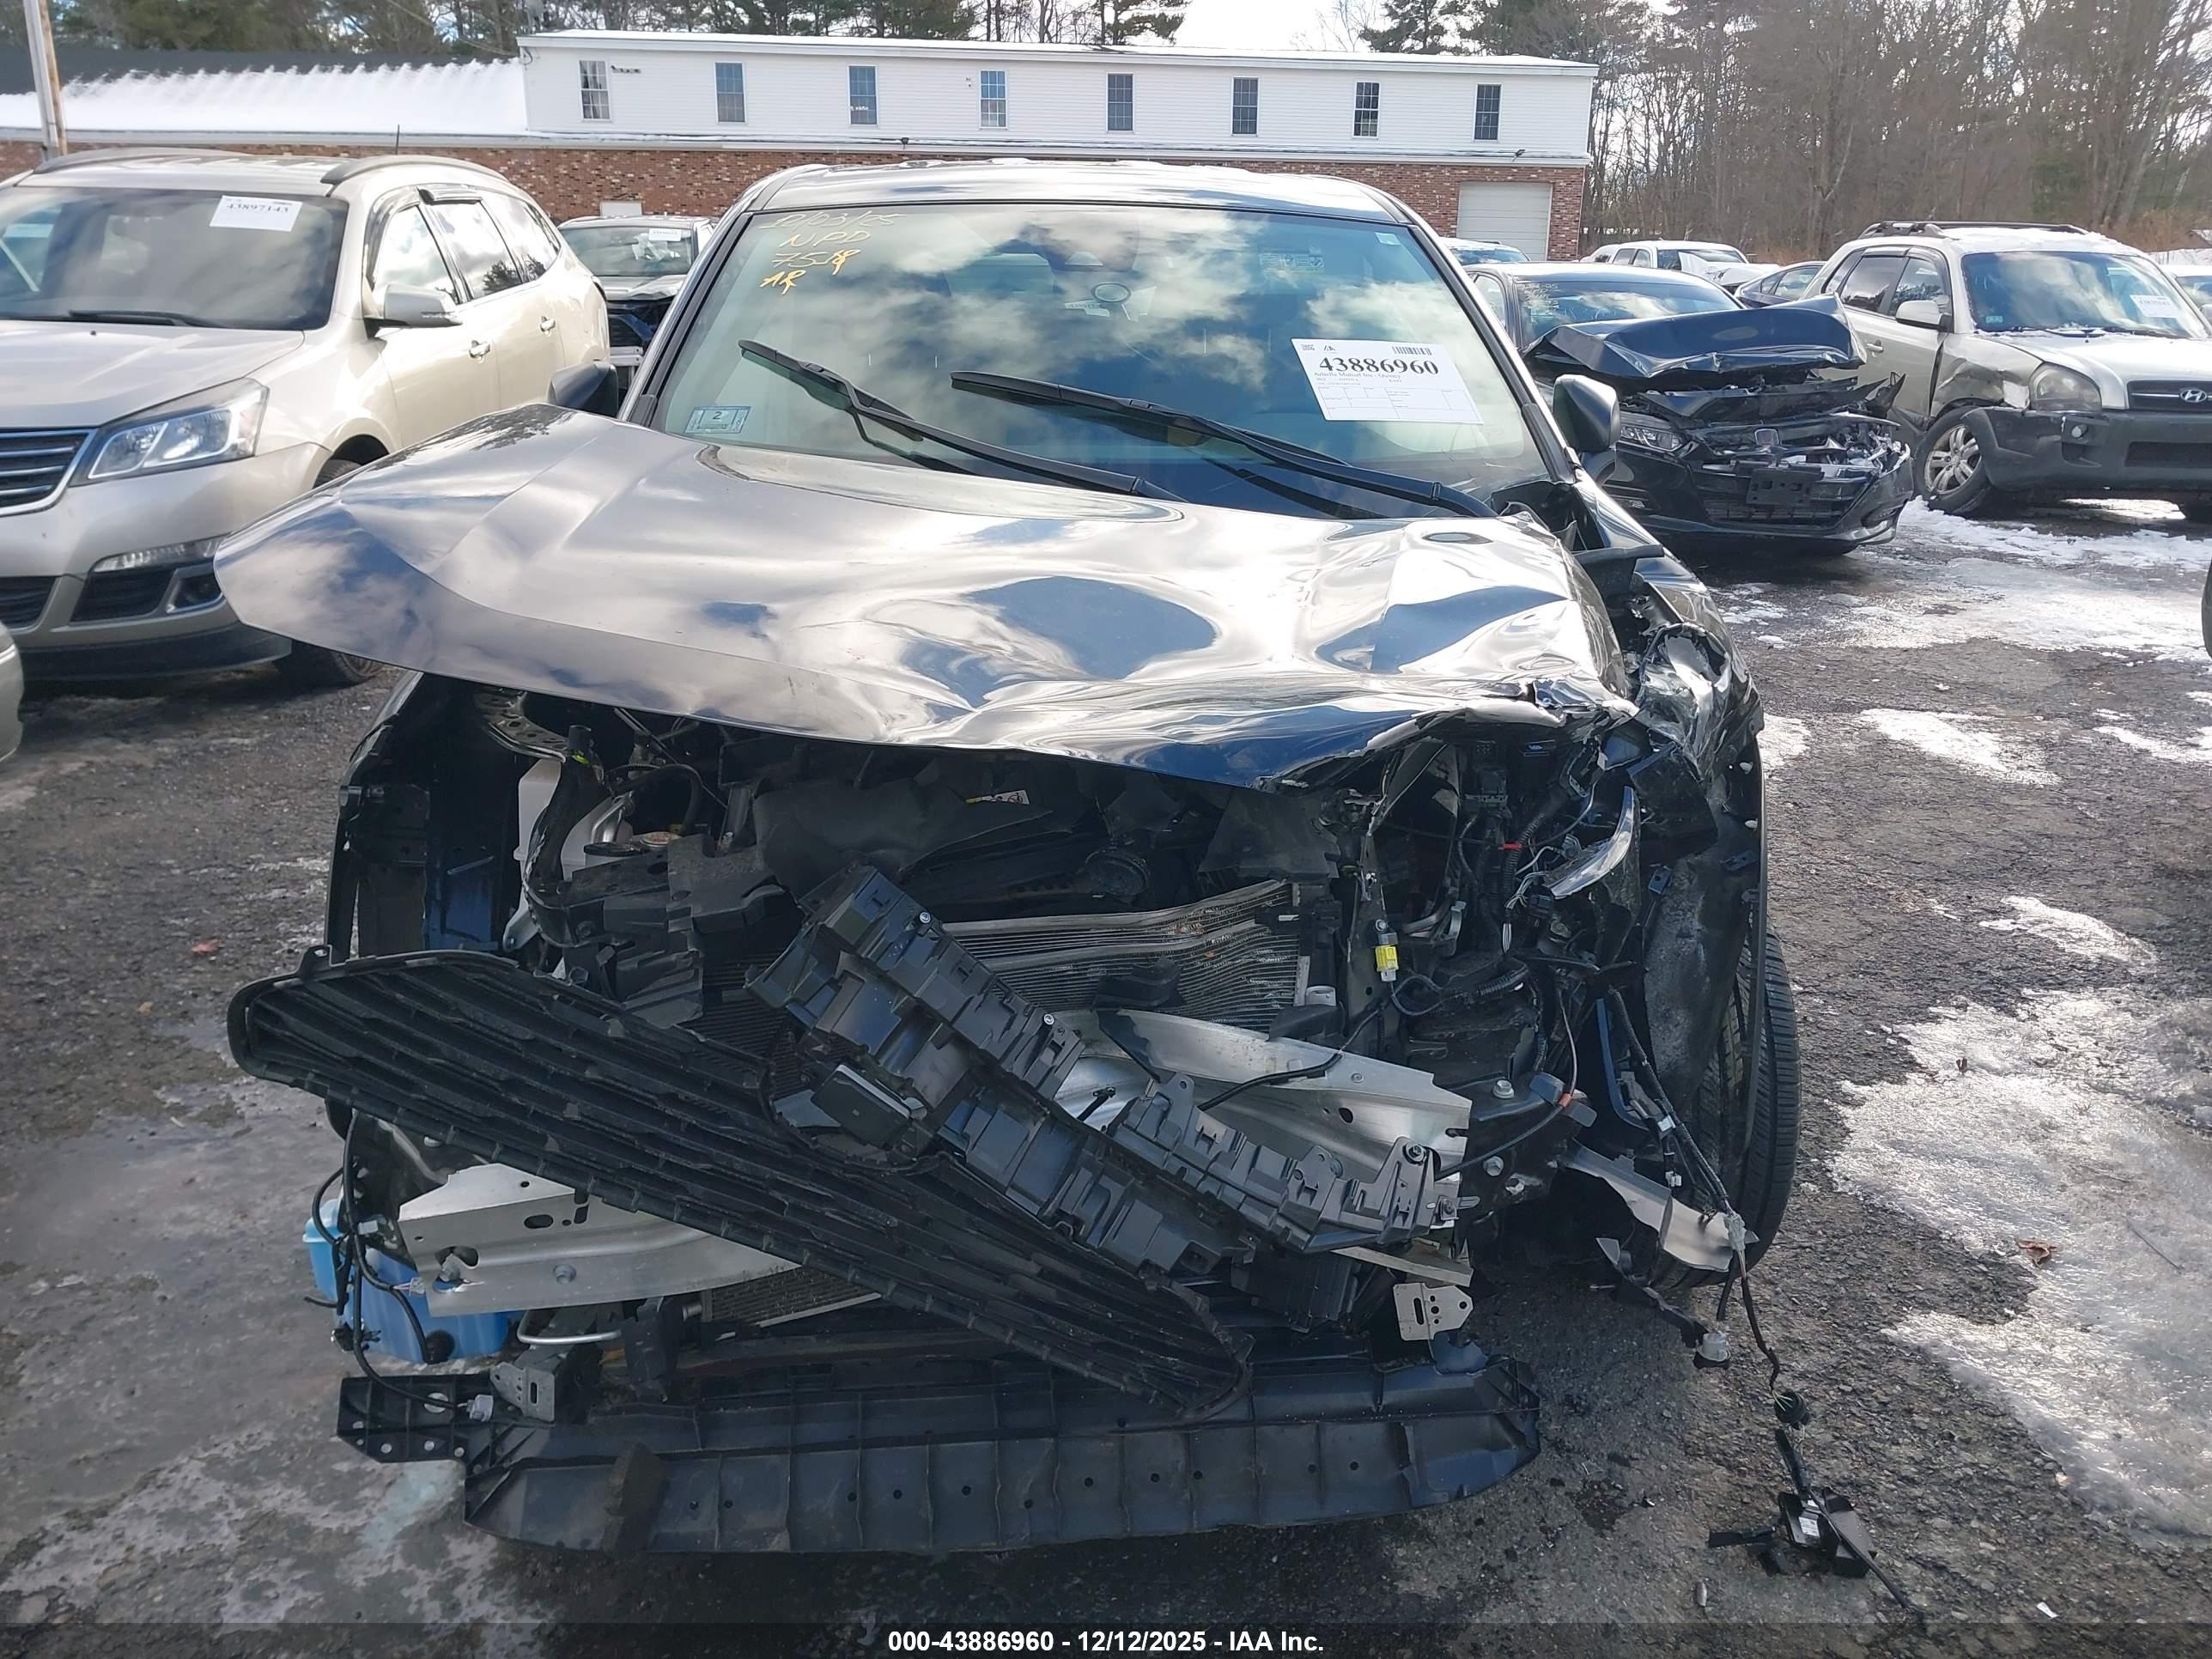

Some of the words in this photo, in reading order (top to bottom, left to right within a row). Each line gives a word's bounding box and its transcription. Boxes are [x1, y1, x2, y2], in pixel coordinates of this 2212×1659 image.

[779, 231, 872, 247] NPD
[1319, 356, 1439, 375] 43886960
[712, 410, 723, 420] 2
